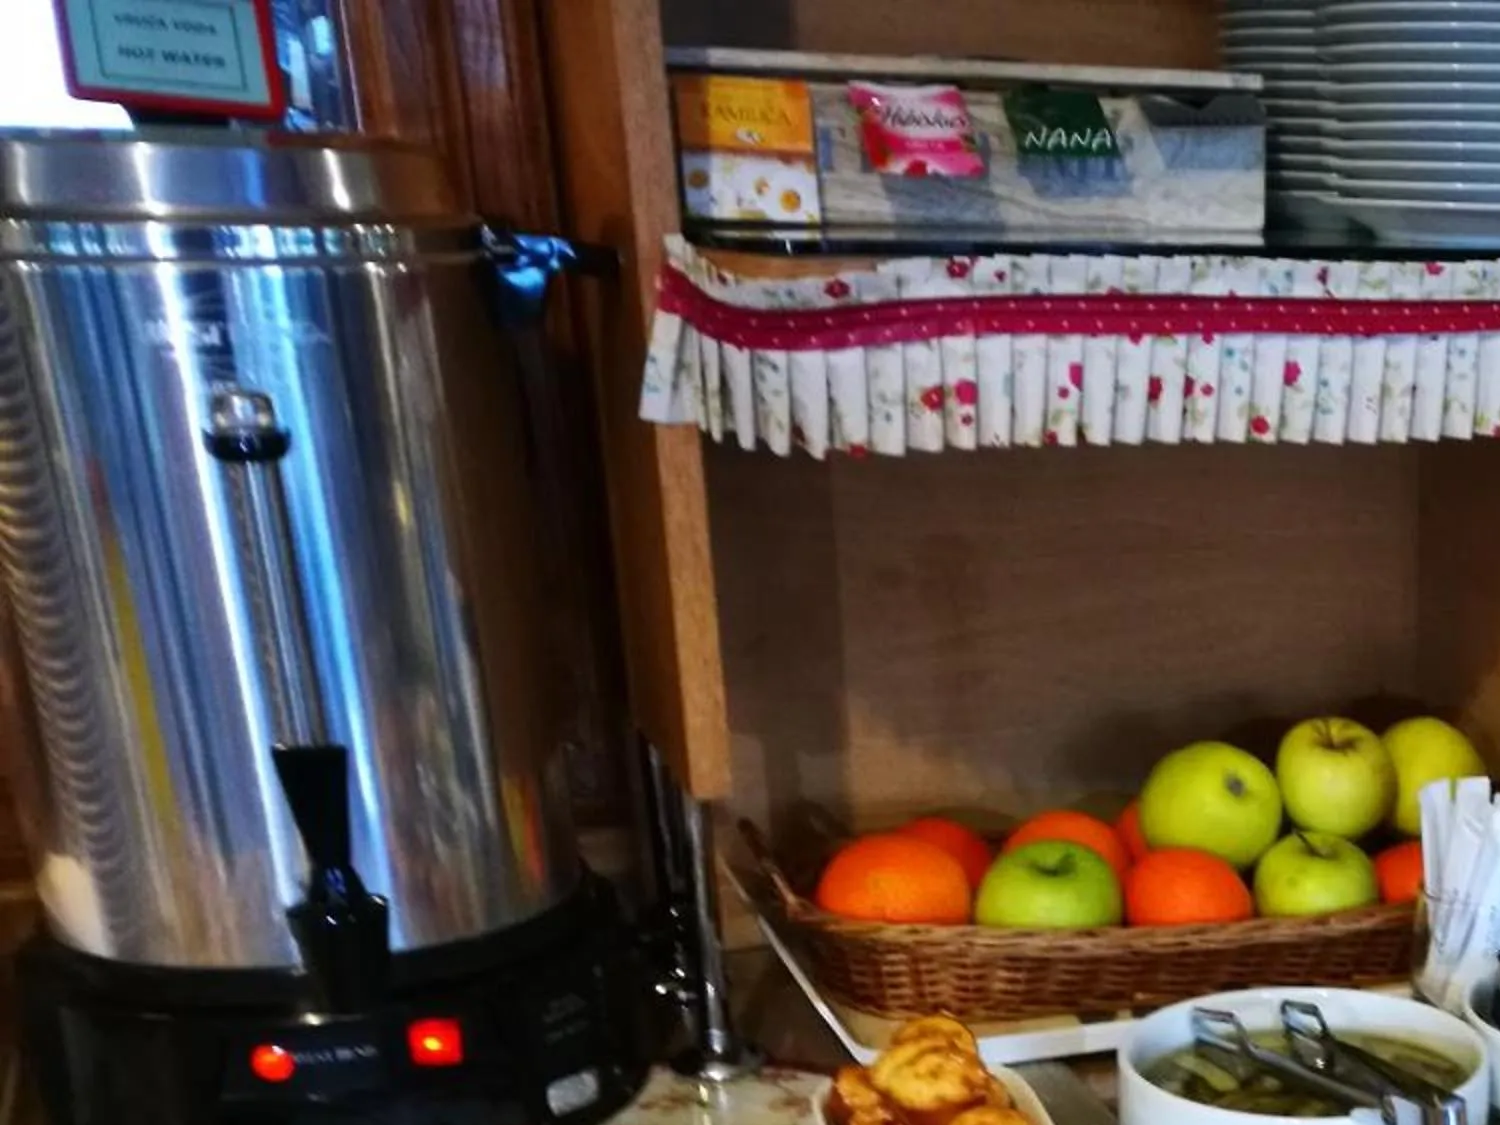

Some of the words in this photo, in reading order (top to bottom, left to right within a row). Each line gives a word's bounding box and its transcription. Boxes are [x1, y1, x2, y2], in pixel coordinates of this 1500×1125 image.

[117, 44, 155, 60] HOT
[161, 49, 226, 69] WATER
[1024, 127, 1113, 151] NANA
